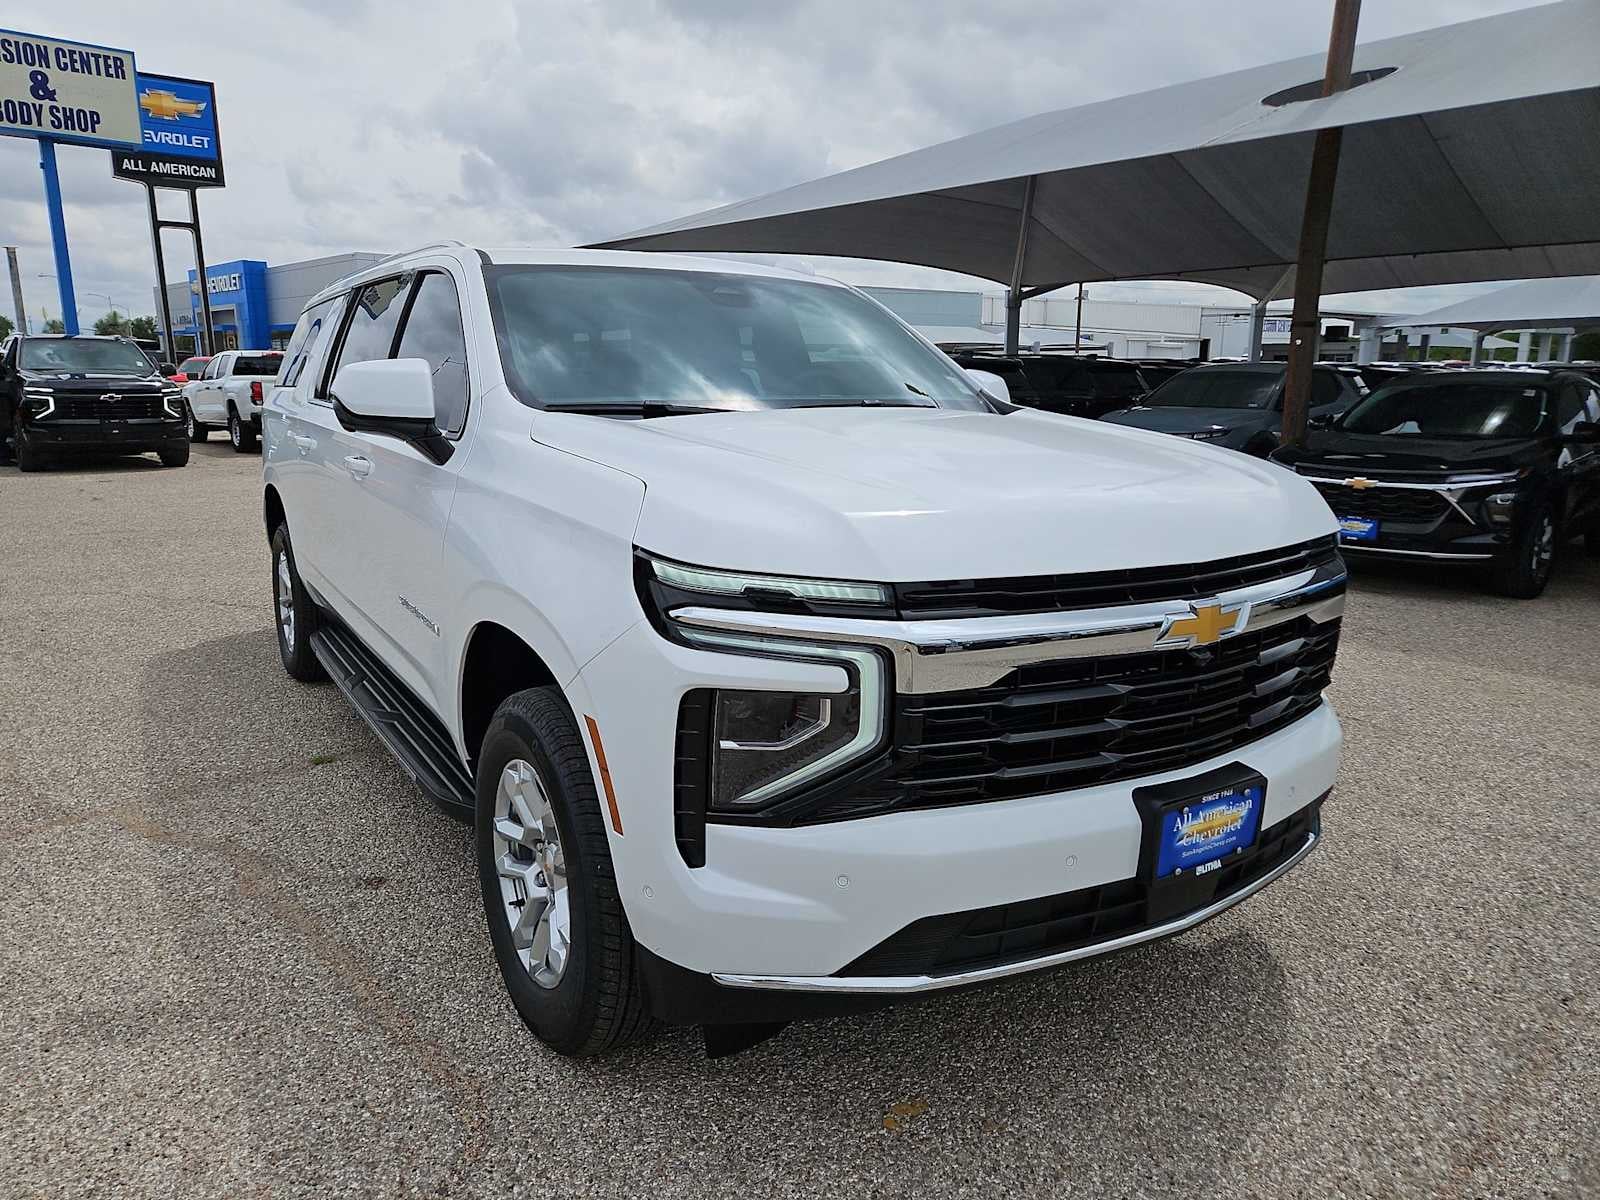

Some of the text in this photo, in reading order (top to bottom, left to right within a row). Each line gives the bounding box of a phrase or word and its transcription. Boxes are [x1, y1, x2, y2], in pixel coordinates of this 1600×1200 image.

[0, 38, 127, 80] SION CENTER
[29, 70, 57, 102] &
[49, 105, 101, 133] SHOP
[144, 130, 210, 149] EVROLET
[122, 158, 216, 179] ALL AMERICAN
[207, 273, 240, 294] HEVROLET
[1173, 799, 1253, 832] All American
[1183, 819, 1241, 846] Chevrolet
